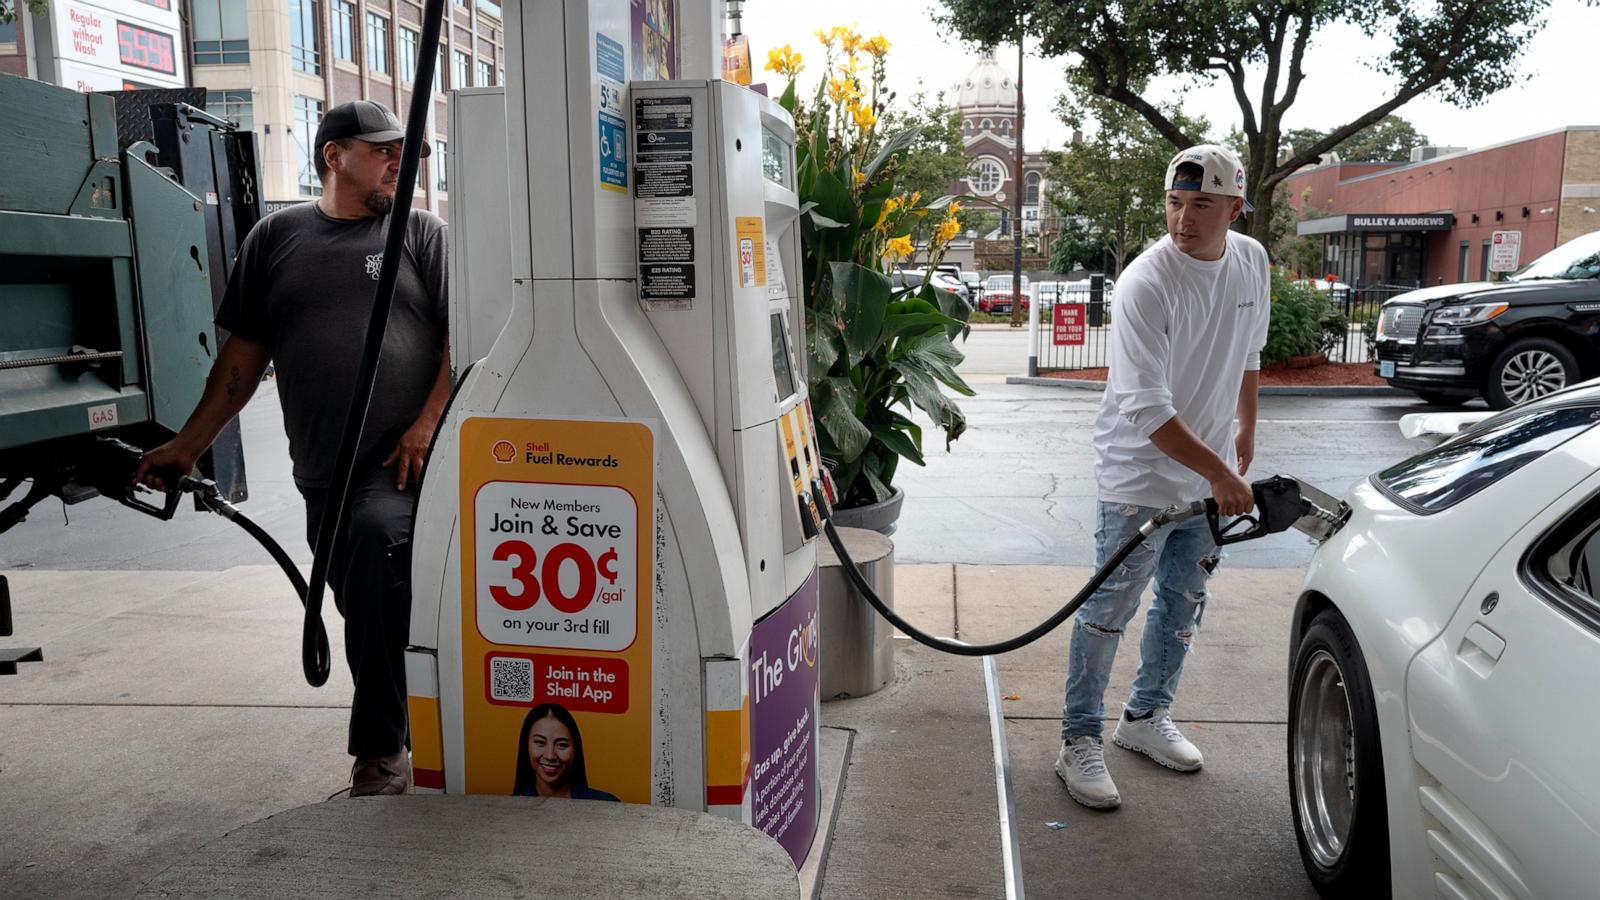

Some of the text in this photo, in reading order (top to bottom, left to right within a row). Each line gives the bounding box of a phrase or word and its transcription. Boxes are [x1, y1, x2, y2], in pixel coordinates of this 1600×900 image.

[69, 8, 102, 28] Regular
[72, 27, 103, 45] without
[73, 40, 96, 57] Wash
[1353, 217, 1445, 226] BULLEY & ANDREWS
[1061, 309, 1078, 317] THANK
[1064, 317, 1075, 325] YOU
[1056, 325, 1083, 333] FOR YOUR
[1056, 333, 1082, 341] BUSINESS
[92, 408, 114, 424] GAS
[526, 441, 550, 452] Shell
[525, 452, 619, 468] Fuel Rewards
[511, 497, 601, 513] New Members
[489, 512, 622, 539] Join & Save
[503, 618, 610, 635] on your 3rd fill
[545, 665, 616, 683] Join in the
[752, 650, 783, 705] The
[546, 682, 613, 704] Shell App
[754, 757, 770, 781] Gas
[770, 747, 783, 765] up,
[783, 728, 797, 755] give
[755, 791, 760, 806] A
[760, 772, 781, 804] portion
[780, 760, 787, 777] of
[755, 802, 770, 826] fuels
[769, 775, 795, 810] donations
[777, 815, 788, 838] and
